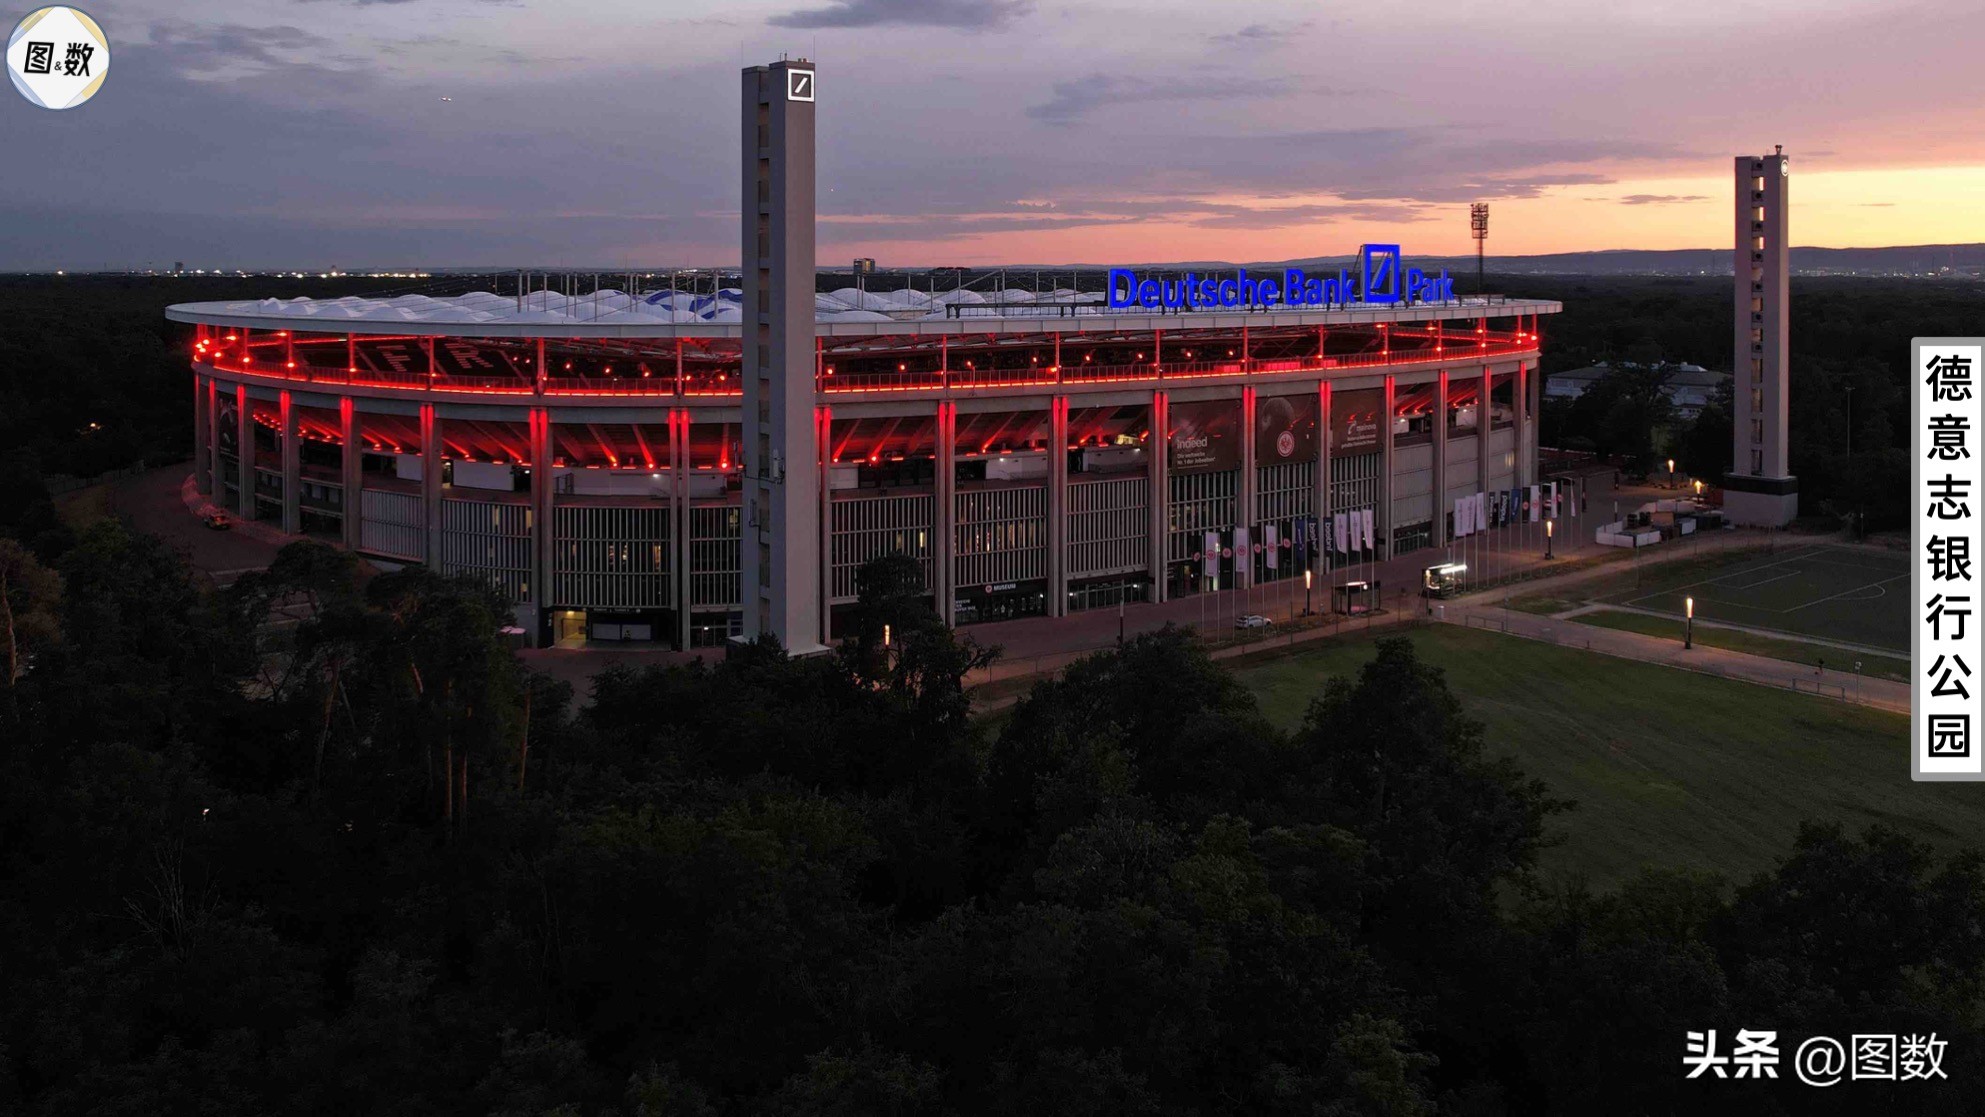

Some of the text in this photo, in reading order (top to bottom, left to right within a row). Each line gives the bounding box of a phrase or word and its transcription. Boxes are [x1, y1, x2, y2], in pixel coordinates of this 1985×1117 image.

[1109, 267, 1454, 309] Deutsche Bank Park
[1176, 436, 1208, 450] indeed
[993, 583, 1017, 591] MUSEUM
